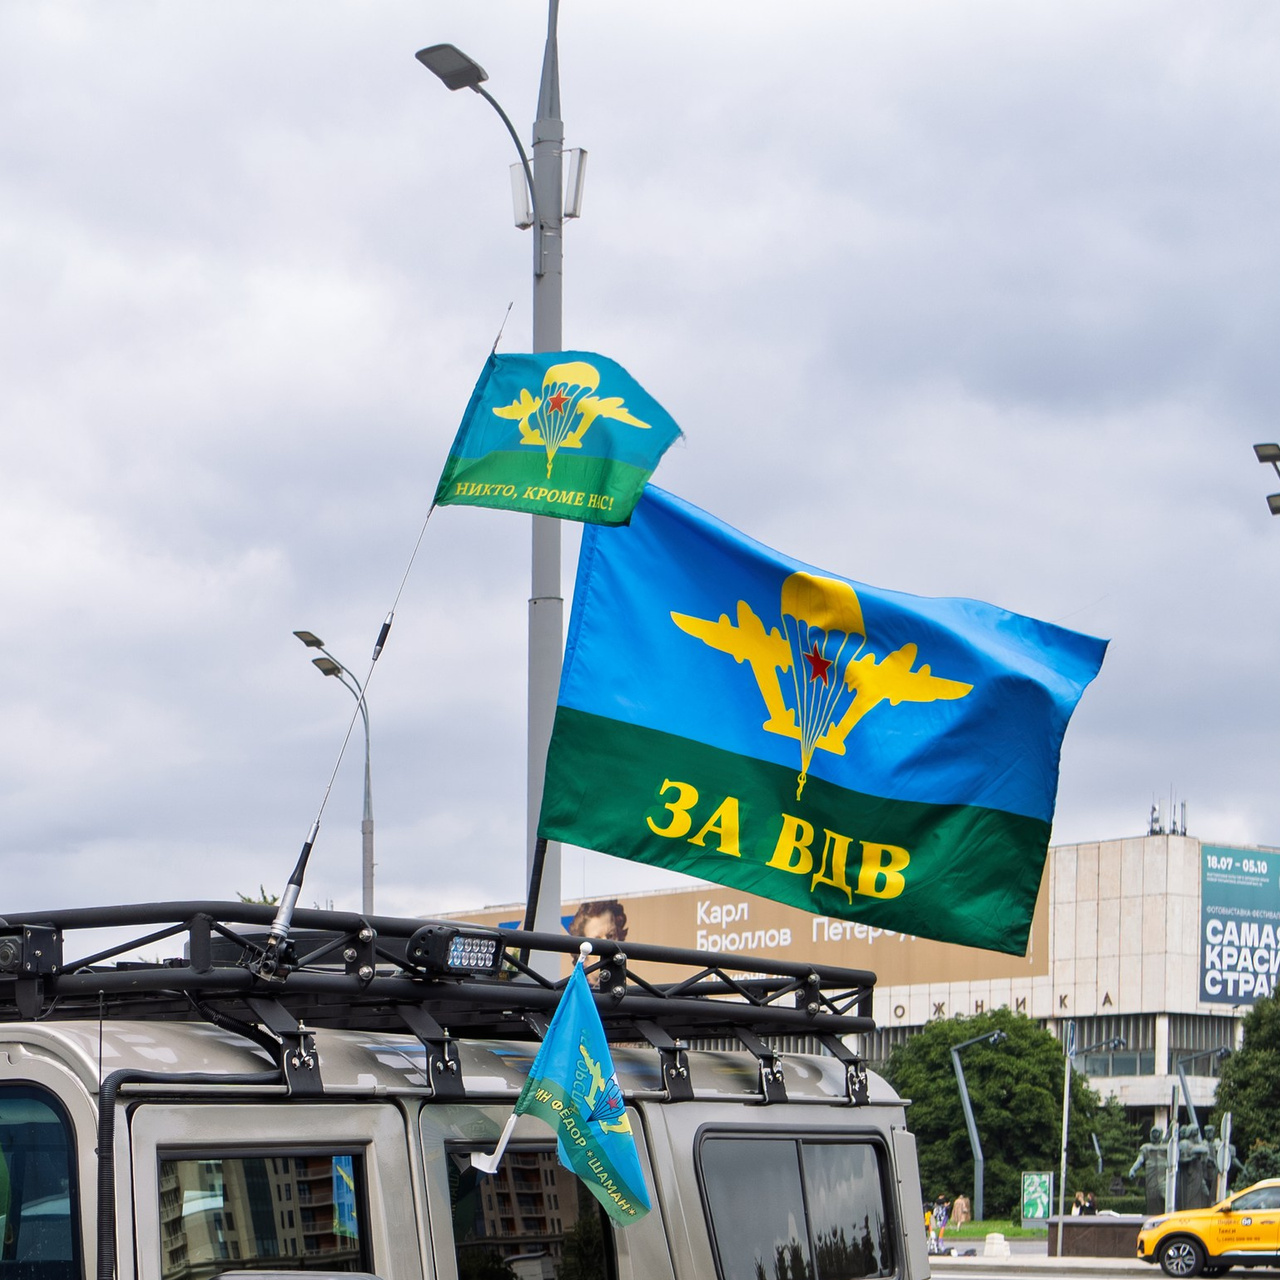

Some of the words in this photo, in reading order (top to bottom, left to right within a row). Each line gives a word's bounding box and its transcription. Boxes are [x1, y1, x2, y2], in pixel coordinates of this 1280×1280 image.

[455, 482, 518, 500] НИКТО,
[523, 486, 585, 505] КРОМЕ
[646, 778, 741, 858] ЗА
[765, 813, 911, 905] ВДВ
[1206, 855, 1233, 871] 18.07
[1242, 859, 1268, 875] 05.10
[697, 901, 749, 929] Карл
[696, 928, 792, 952] Брюллов
[812, 916, 917, 944] Петер
[1206, 918, 1280, 950] САМА
[551, 1100, 587, 1148] ФЁДОР
